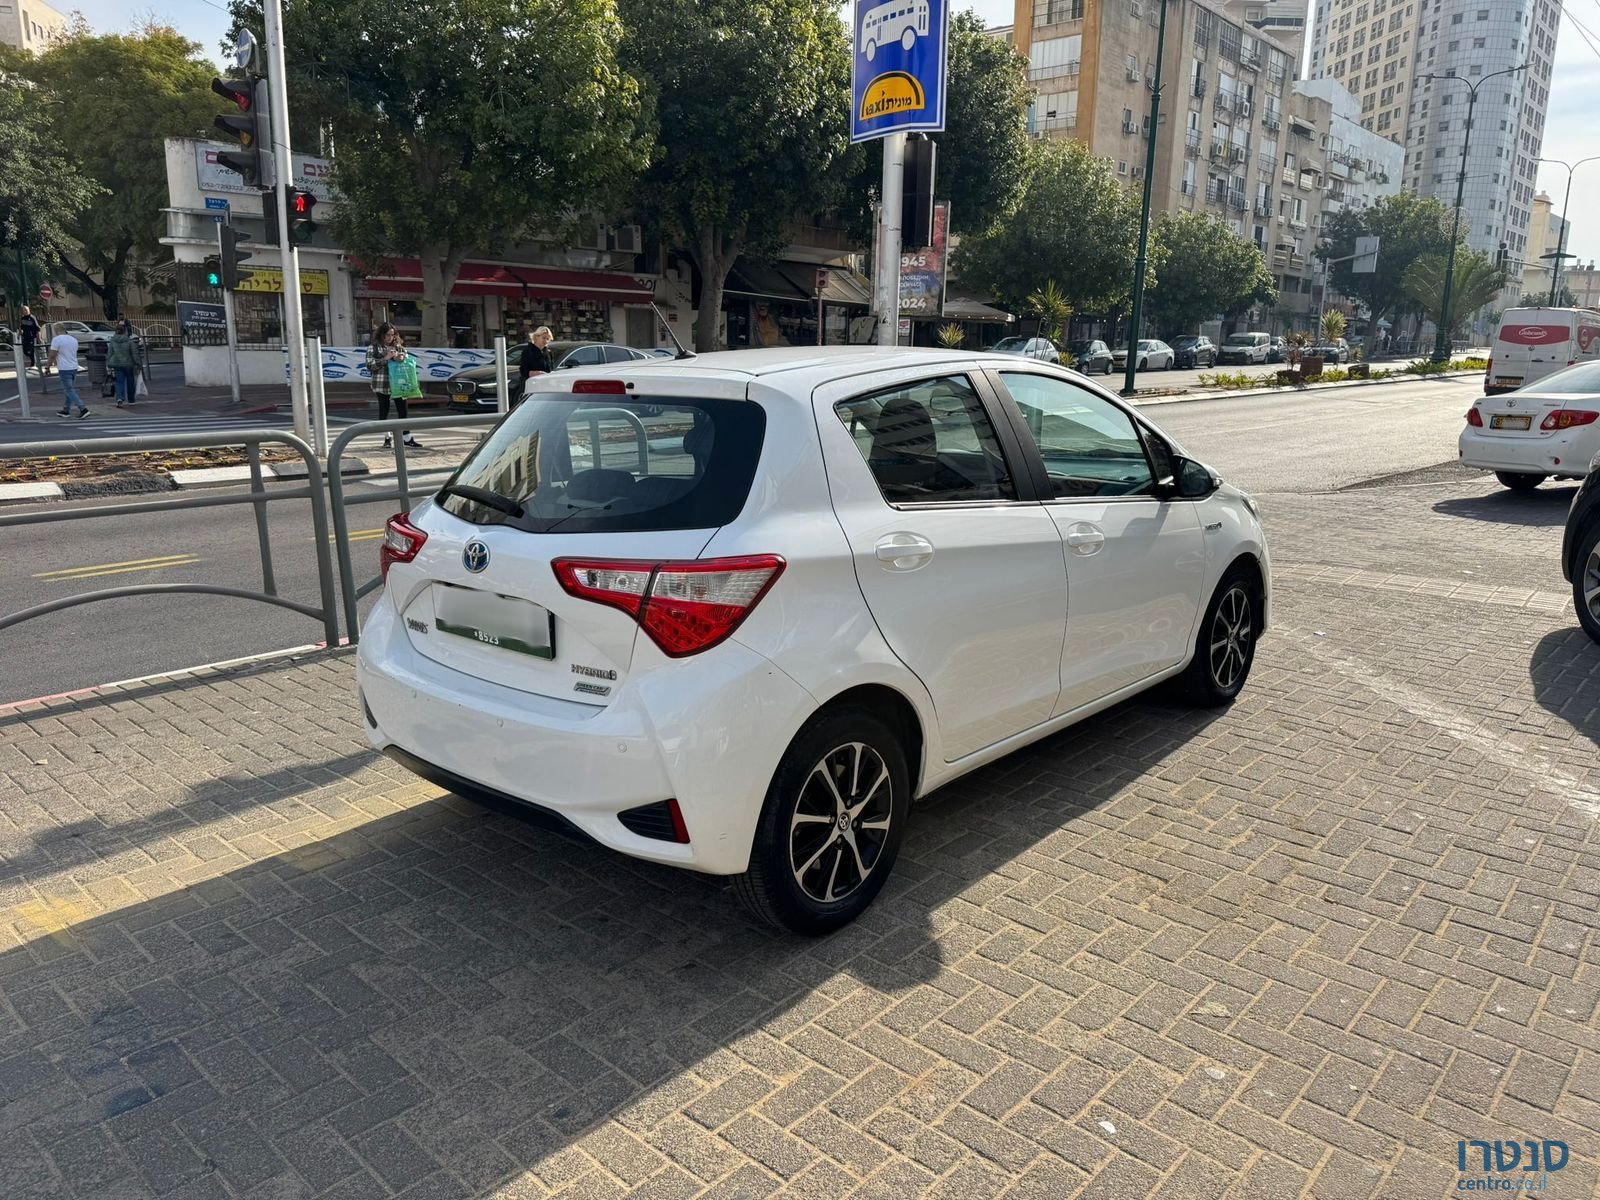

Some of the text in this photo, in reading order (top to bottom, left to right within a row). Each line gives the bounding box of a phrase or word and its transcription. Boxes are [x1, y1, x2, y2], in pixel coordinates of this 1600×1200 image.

[865, 90, 886, 116] taxi
[886, 96, 912, 111] מונית
[901, 256, 926, 267] 945
